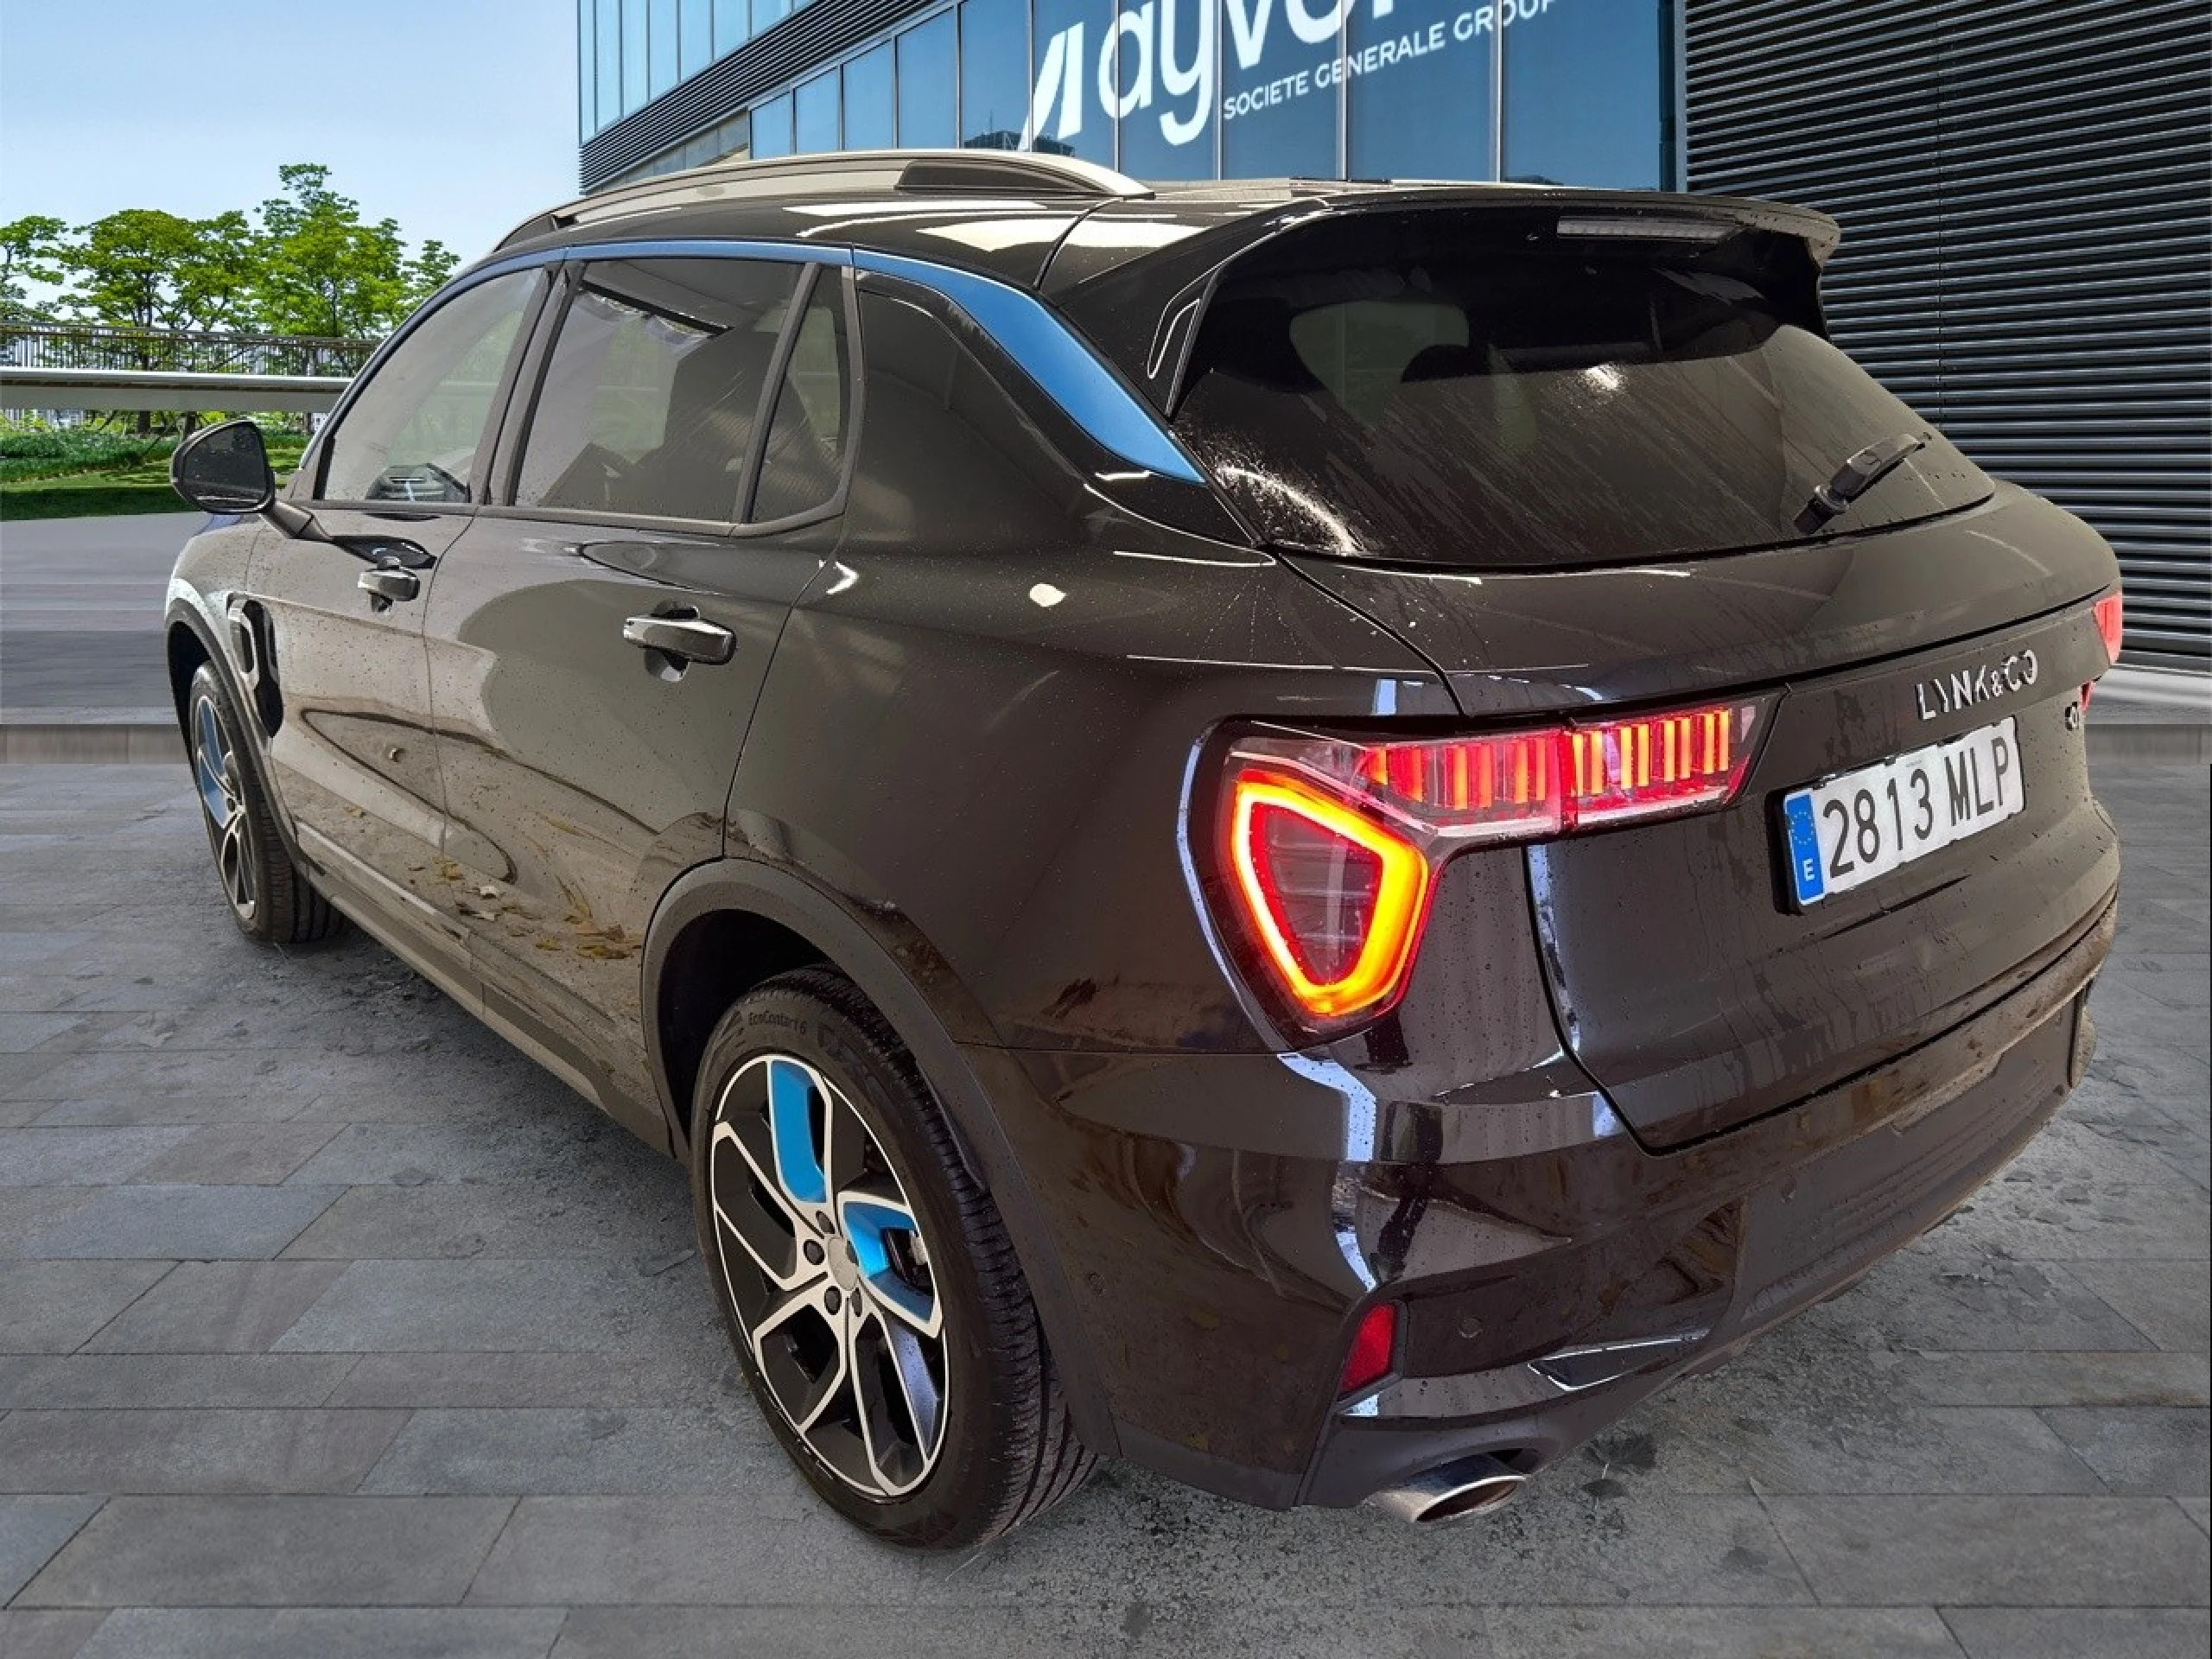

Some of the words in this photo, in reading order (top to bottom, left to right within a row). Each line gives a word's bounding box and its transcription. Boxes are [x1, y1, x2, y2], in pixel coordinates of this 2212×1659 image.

[1224, 71, 1309, 119] SOCIETE
[1314, 22, 1446, 89] GENERALE
[1822, 768, 1934, 879] 2813
[1944, 736, 2009, 827] MLP
[1802, 858, 1815, 881] E
